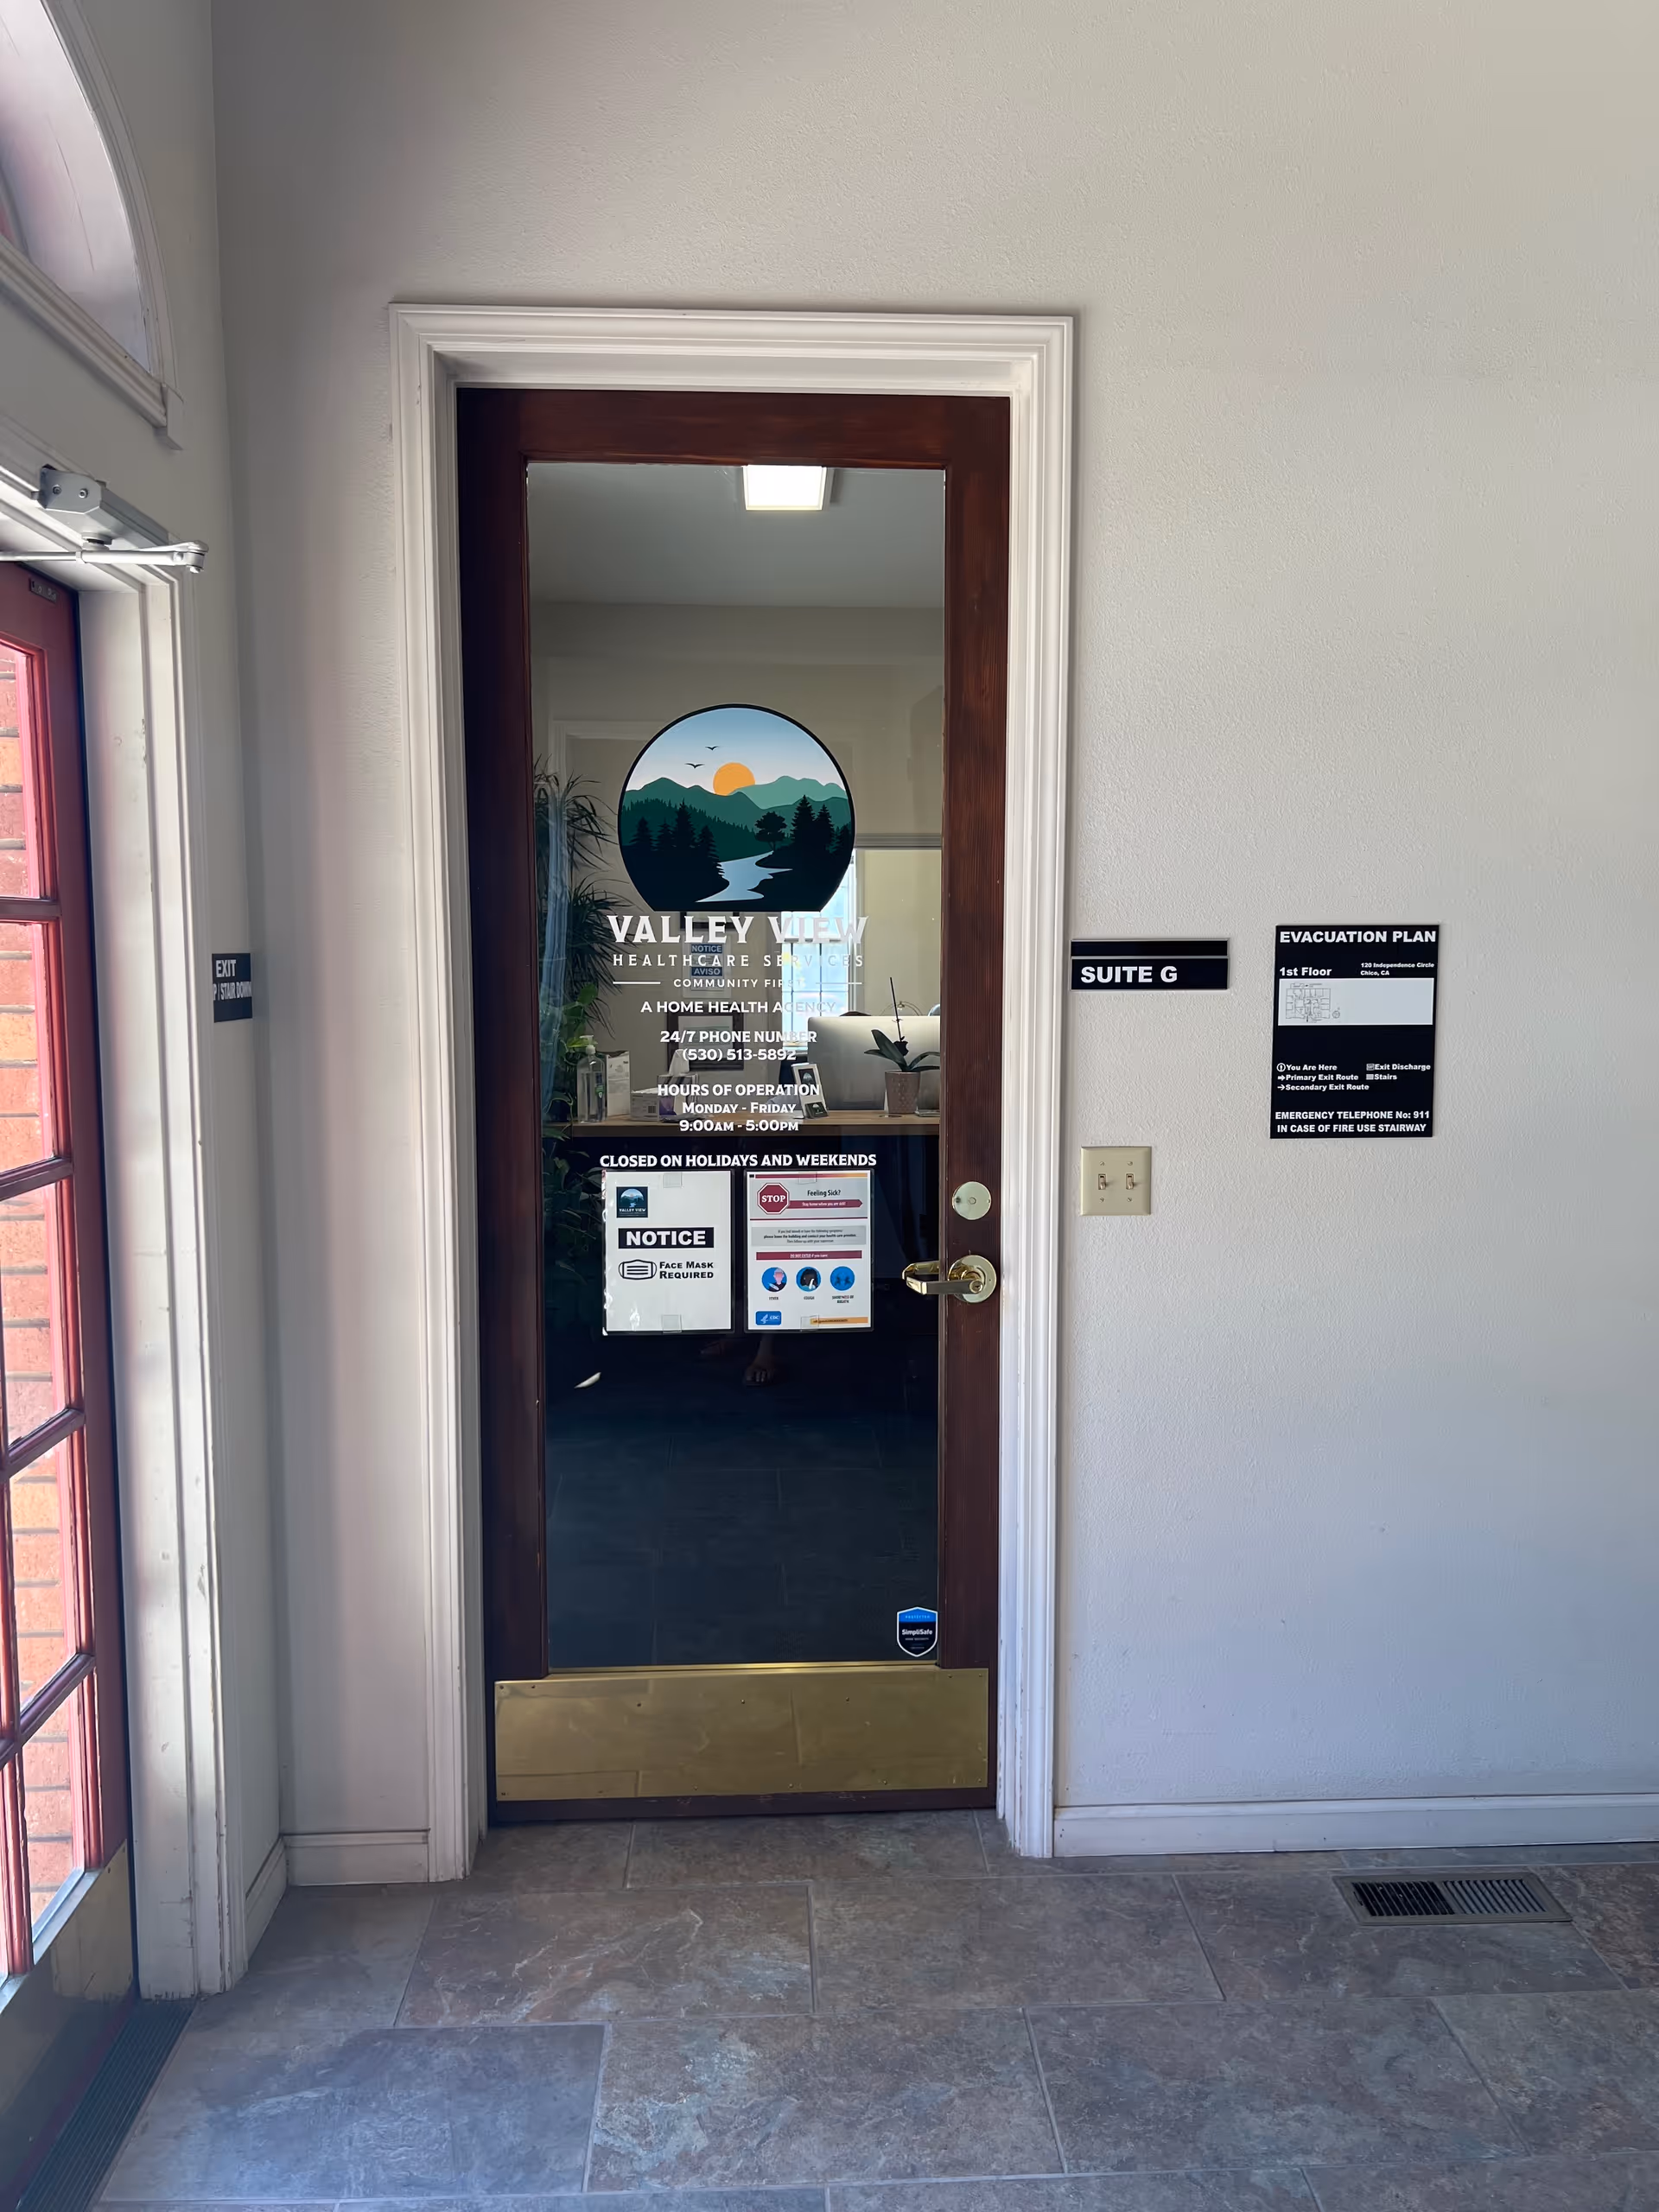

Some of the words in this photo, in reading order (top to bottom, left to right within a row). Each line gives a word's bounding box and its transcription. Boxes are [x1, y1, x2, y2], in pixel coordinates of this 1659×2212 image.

[607, 915, 755, 944] VALLEY
[767, 916, 868, 944] VIEW
[1280, 931, 1387, 944] EVACUATION
[1393, 931, 1436, 943] PLAN
[613, 954, 750, 967] HEALTHCARE
[763, 954, 864, 967] SERVICES
[216, 959, 237, 978] EXIT
[1081, 966, 1153, 983] SUITE
[1160, 965, 1178, 982] G
[1280, 967, 1298, 976] 1st
[1301, 967, 1332, 976] Floor
[673, 978, 759, 988] COMMUNITY
[220, 982, 236, 1001] STAIR
[640, 1001, 652, 1013] A
[657, 1001, 703, 1013] HOME
[709, 1001, 768, 1013] HEALTH
[772, 1001, 836, 1014] AGENCY
[660, 1031, 694, 1044] 24/7
[699, 1031, 751, 1043] PHONE
[754, 1031, 817, 1043] NUMBER
[683, 1048, 723, 1061] (530)
[727, 1048, 797, 1061] 513-5892
[658, 1084, 709, 1096] HOURS
[712, 1084, 732, 1096] OF
[735, 1084, 821, 1096] OPERATION
[1275, 1111, 1334, 1120] EMERGENCY
[1277, 1124, 1287, 1133] IN
[1290, 1124, 1315, 1133] CASE
[1318, 1124, 1331, 1133] OF
[1378, 1123, 1427, 1132] STAIRWAY
[600, 1155, 657, 1167] CLOSED
[660, 1155, 683, 1166] ON
[685, 1154, 758, 1167] HOLIDAYS
[761, 1154, 792, 1166] AND
[797, 1154, 877, 1166] WEEKENDS
[626, 1230, 706, 1246] NOTICE
